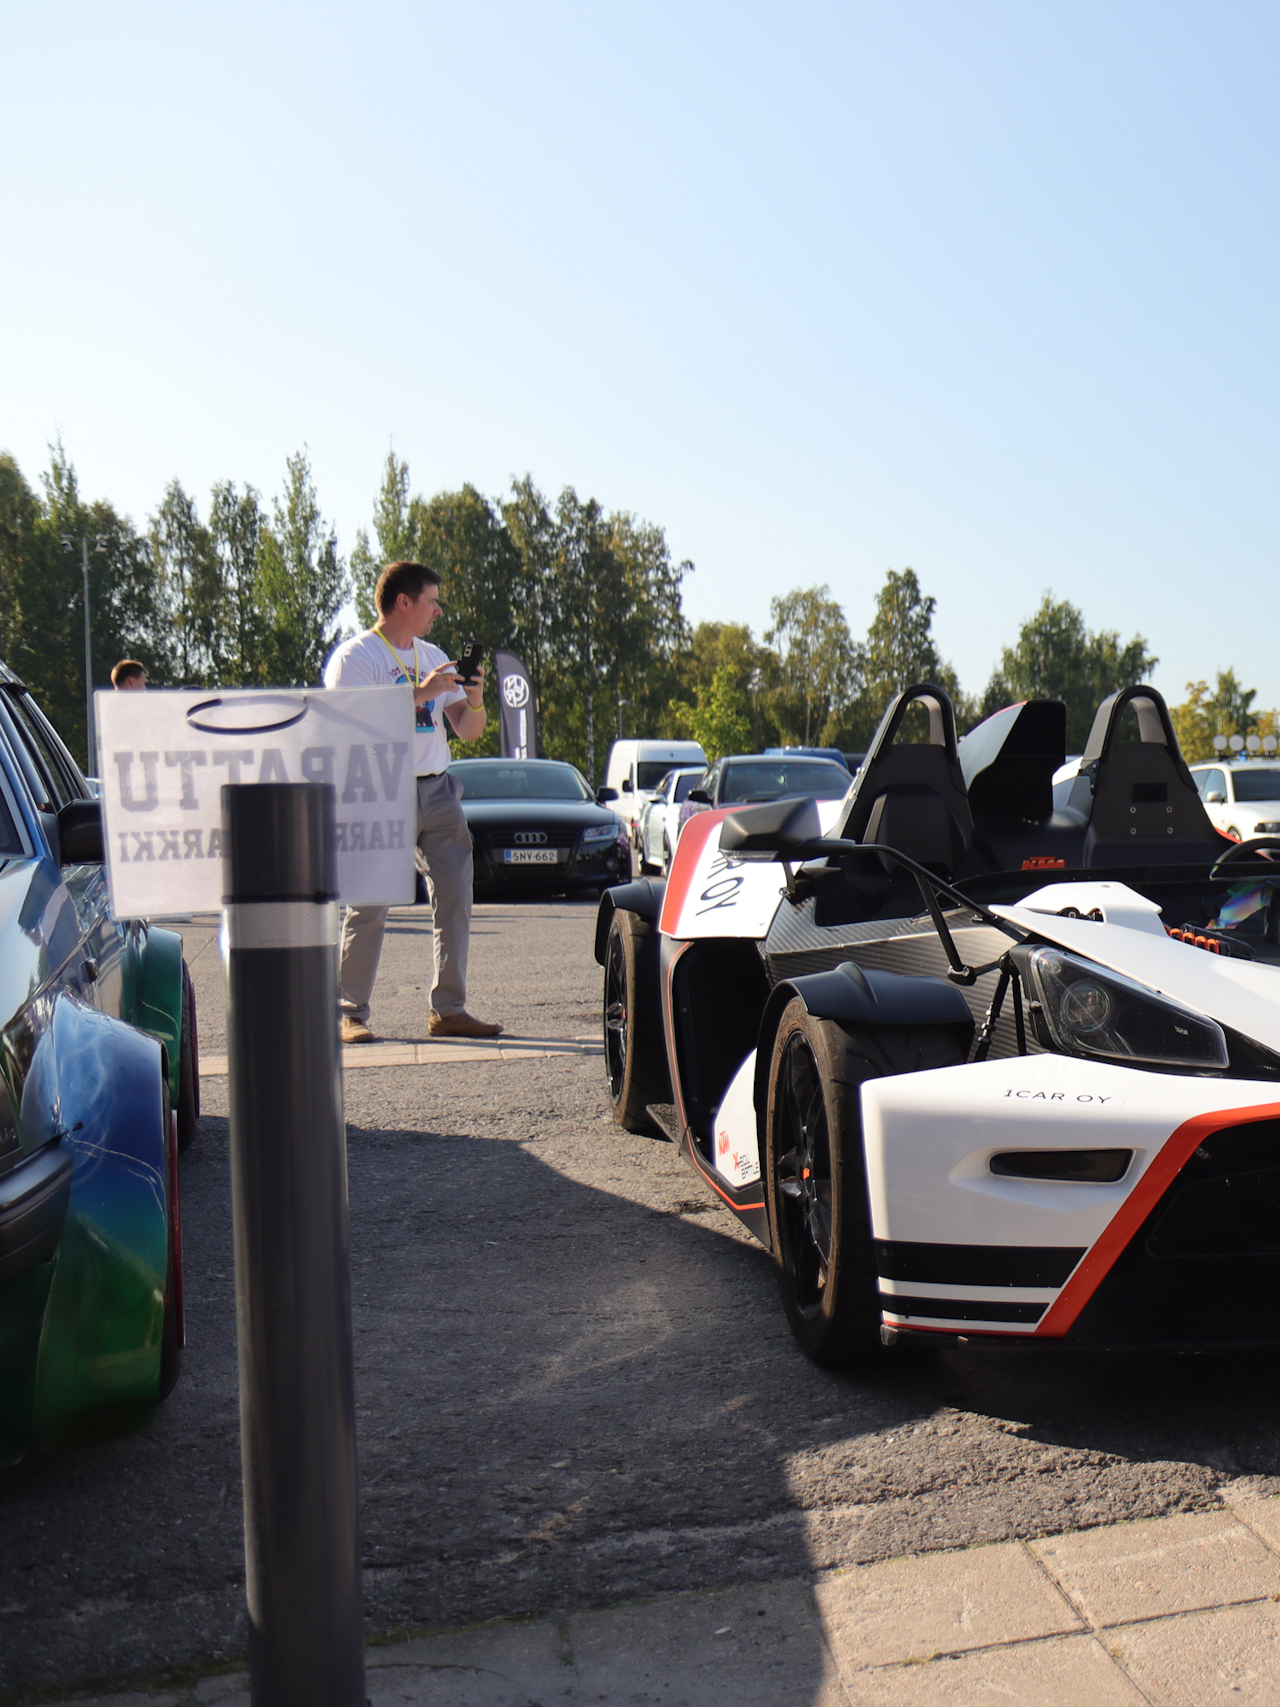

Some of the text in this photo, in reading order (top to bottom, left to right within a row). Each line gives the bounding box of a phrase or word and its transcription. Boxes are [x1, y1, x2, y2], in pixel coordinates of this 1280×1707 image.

[1021, 856, 1066, 870] KTM
[1003, 1089, 1112, 1104] 1CAR OY
[718, 1130, 730, 1156] KTM
